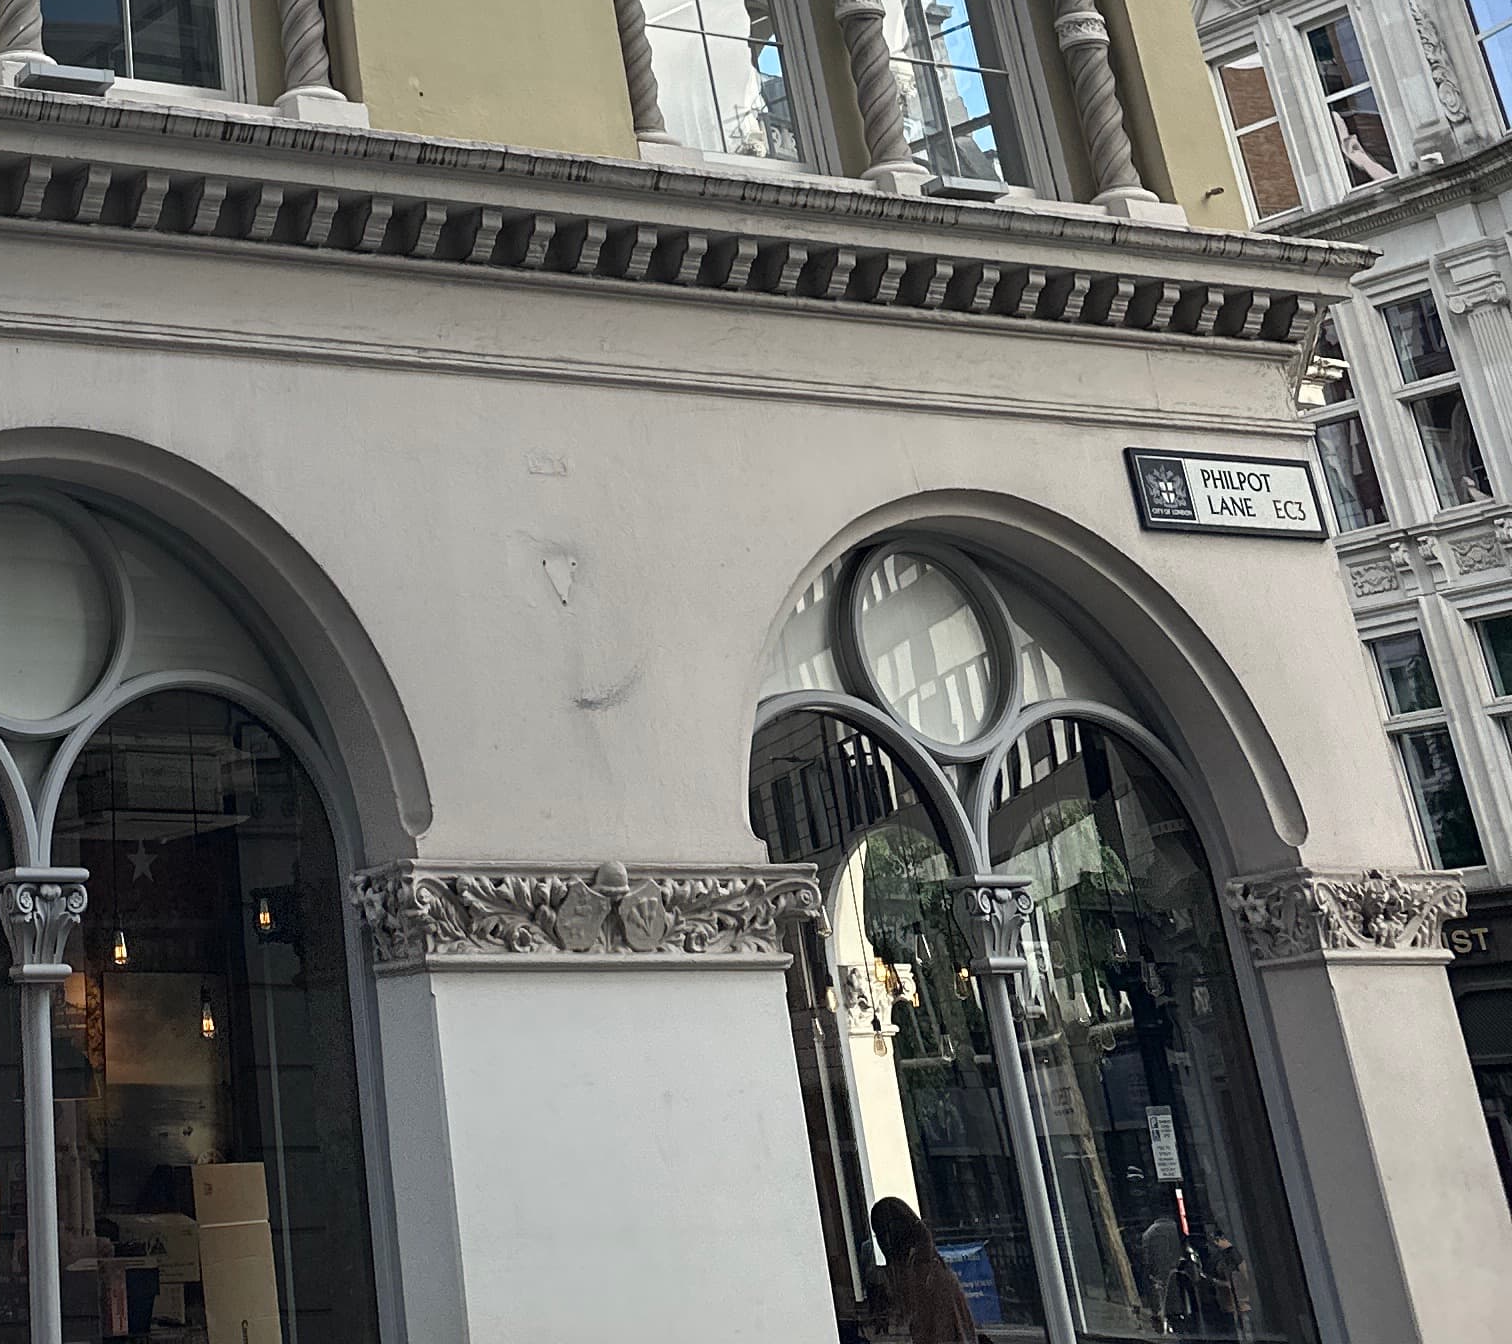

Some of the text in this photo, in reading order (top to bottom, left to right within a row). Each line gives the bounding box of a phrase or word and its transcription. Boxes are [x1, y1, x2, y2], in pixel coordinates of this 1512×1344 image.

[1201, 469, 1270, 492] PHILPOT
[1207, 496, 1306, 521] LANE EC3
